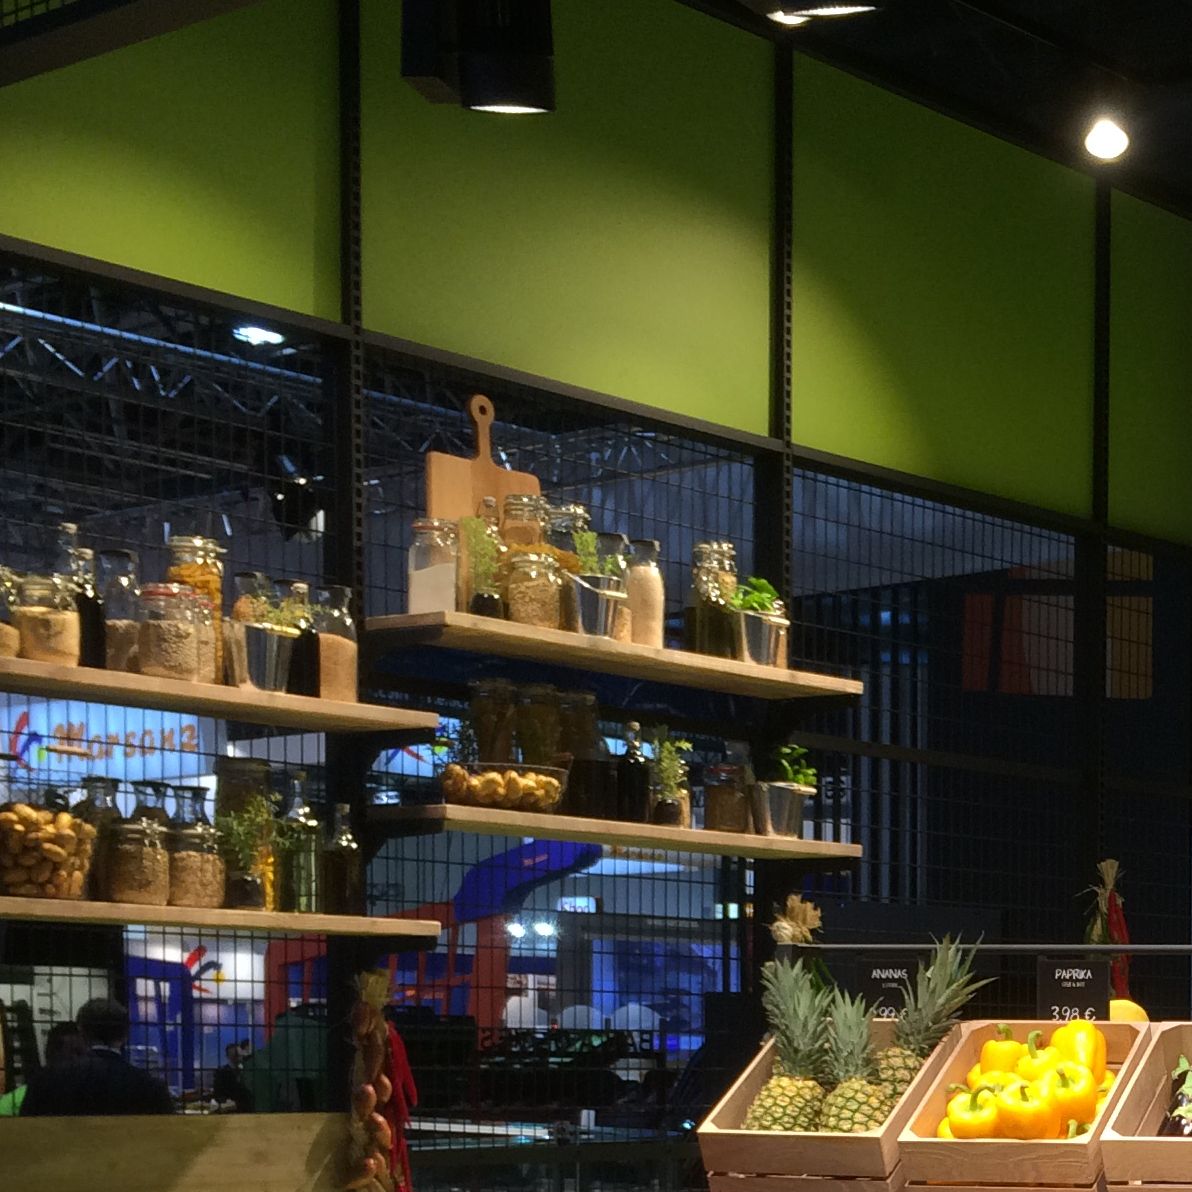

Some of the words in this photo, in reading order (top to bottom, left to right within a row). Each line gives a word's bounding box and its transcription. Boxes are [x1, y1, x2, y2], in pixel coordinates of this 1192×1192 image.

[871, 968, 908, 979] ANANAS
[1054, 968, 1093, 980] PAPRIKA
[1084, 1007, 1097, 1021] €
